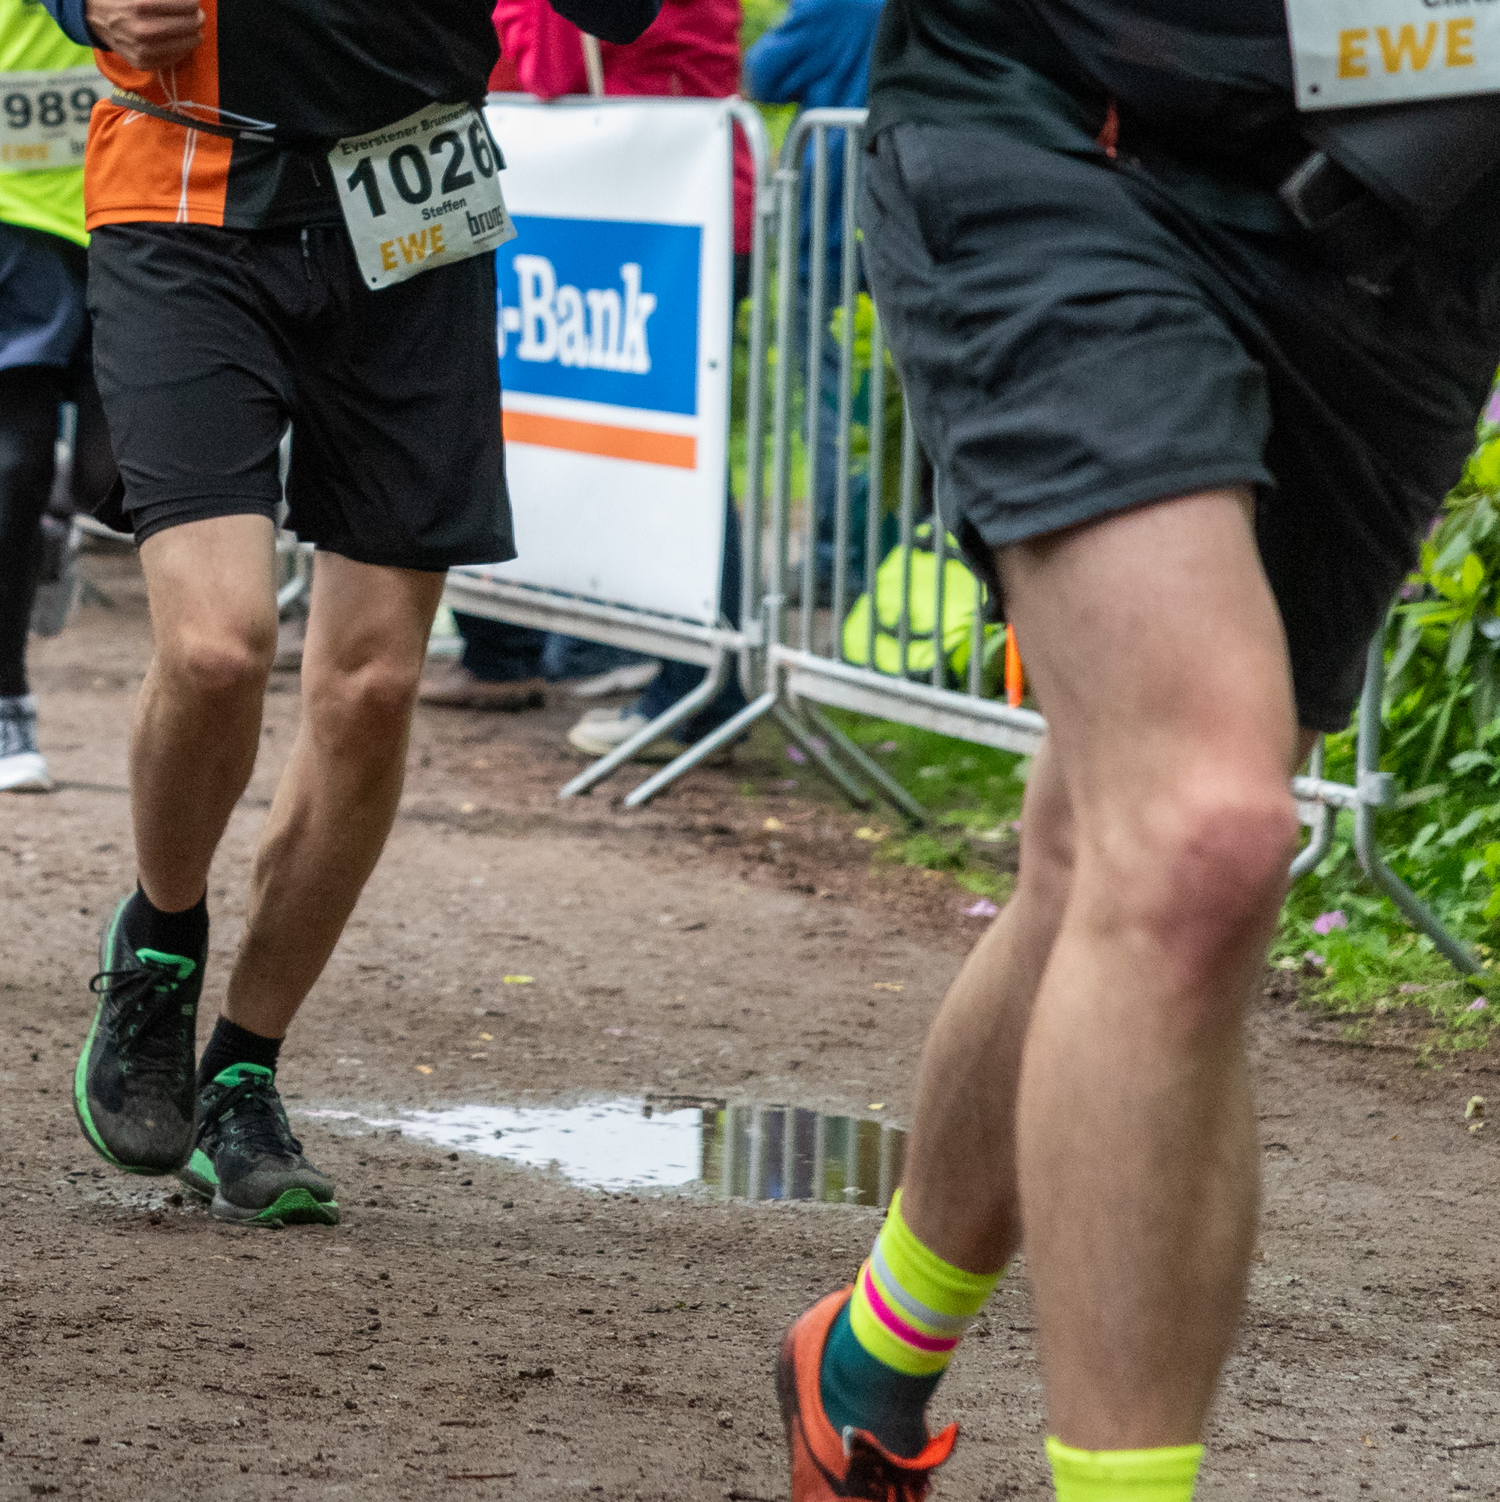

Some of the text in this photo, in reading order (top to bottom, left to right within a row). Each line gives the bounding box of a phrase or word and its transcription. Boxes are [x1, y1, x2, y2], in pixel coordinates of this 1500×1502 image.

[1336, 16, 1476, 80] EWE
[3, 86, 99, 131] 989
[340, 125, 418, 156] Everstener
[346, 118, 495, 219] 1026
[421, 197, 467, 221] Steffen
[379, 223, 446, 272] EWE
[497, 253, 658, 375] -Bank
